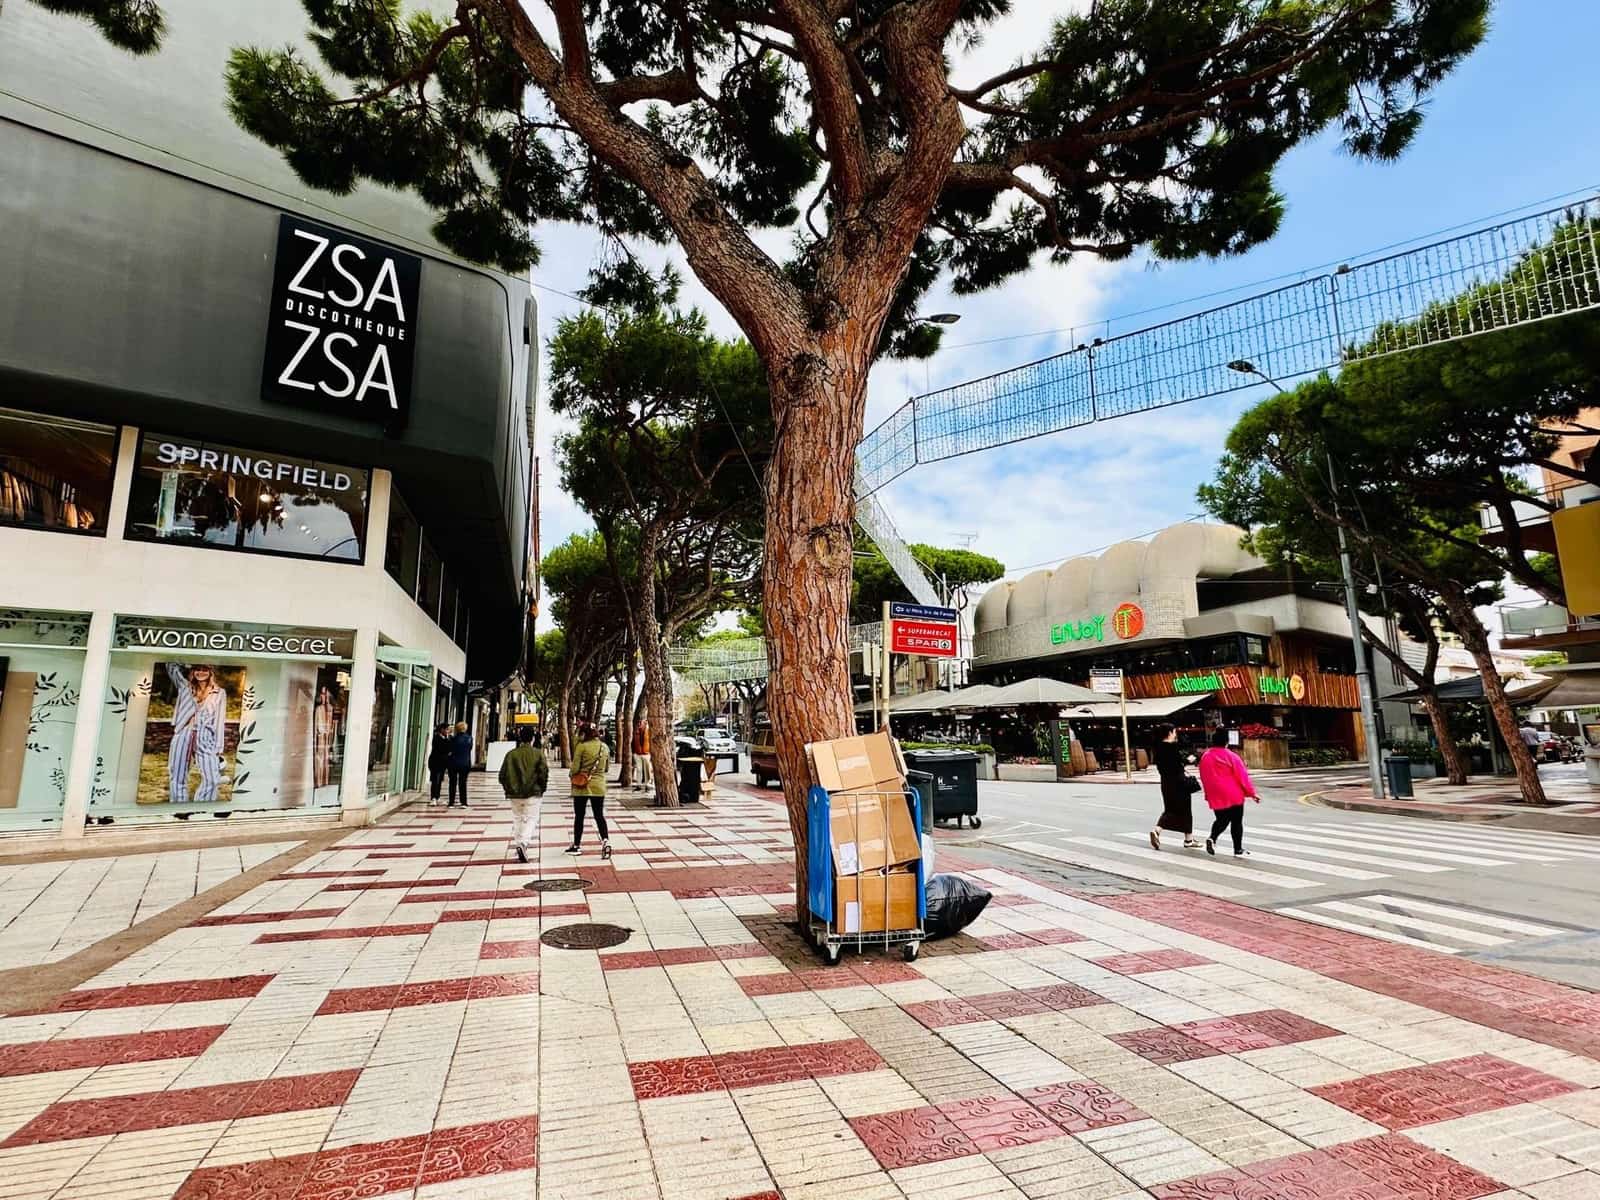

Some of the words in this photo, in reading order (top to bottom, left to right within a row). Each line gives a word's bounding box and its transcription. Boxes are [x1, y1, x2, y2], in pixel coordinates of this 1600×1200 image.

[288, 228, 406, 322] ZSA
[285, 298, 405, 341] DISCOTHEQUE
[278, 319, 399, 410] ZSA
[157, 442, 352, 491] SPRINGFIELD
[137, 627, 335, 655] women'secret
[907, 628, 951, 637] SUPERMERCAT
[907, 638, 939, 648] SPAR
[1223, 673, 1242, 689] bar
